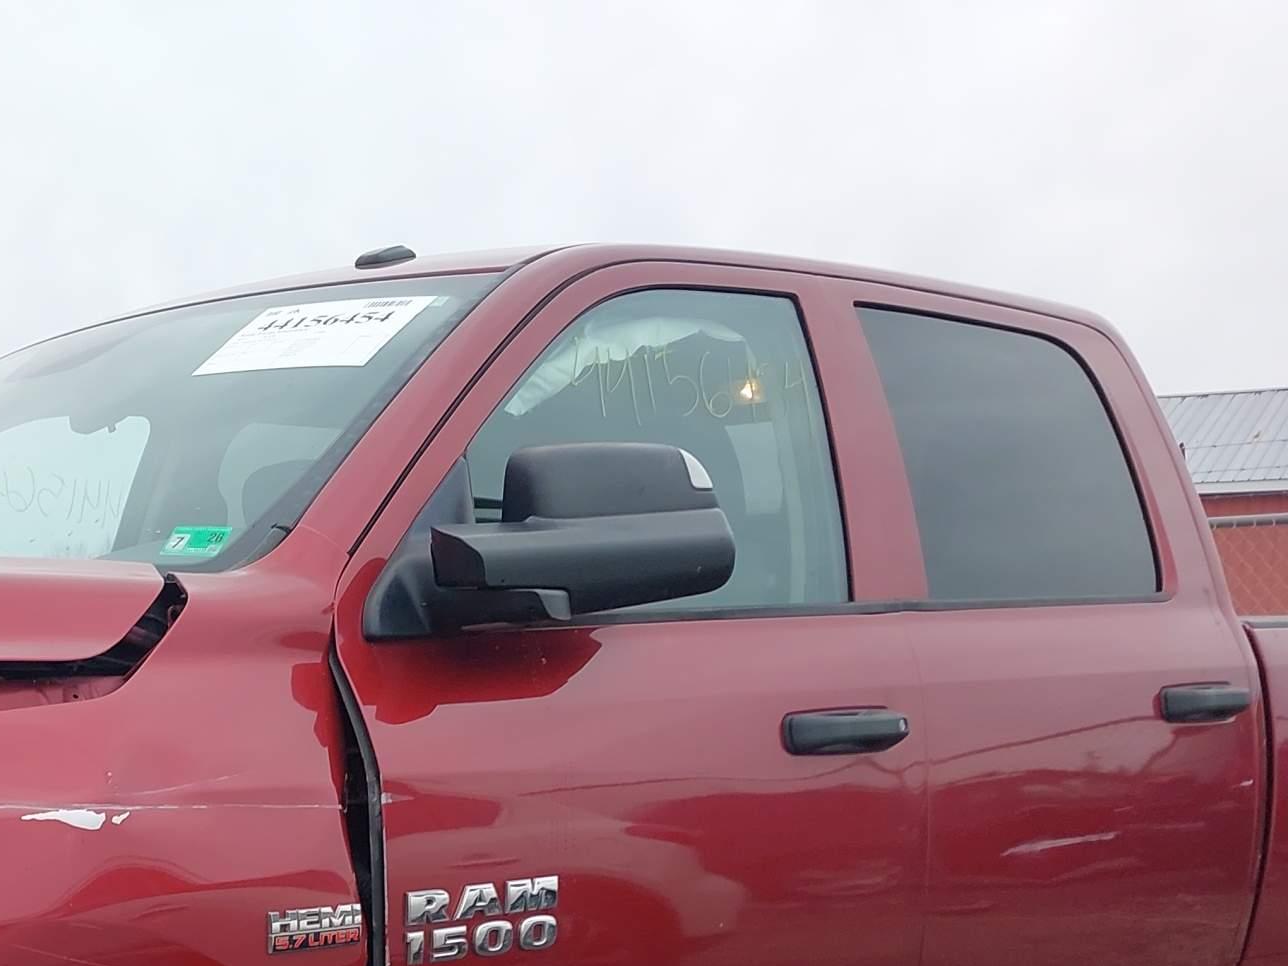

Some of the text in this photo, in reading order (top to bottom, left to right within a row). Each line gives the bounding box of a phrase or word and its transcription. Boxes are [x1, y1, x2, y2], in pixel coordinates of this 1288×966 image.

[257, 310, 396, 332] 44156454
[171, 536, 185, 549] 7
[404, 875, 559, 926] RAM
[268, 903, 362, 934] HEMI
[275, 928, 361, 950] 5.7 LITER
[405, 914, 558, 966] 1500
